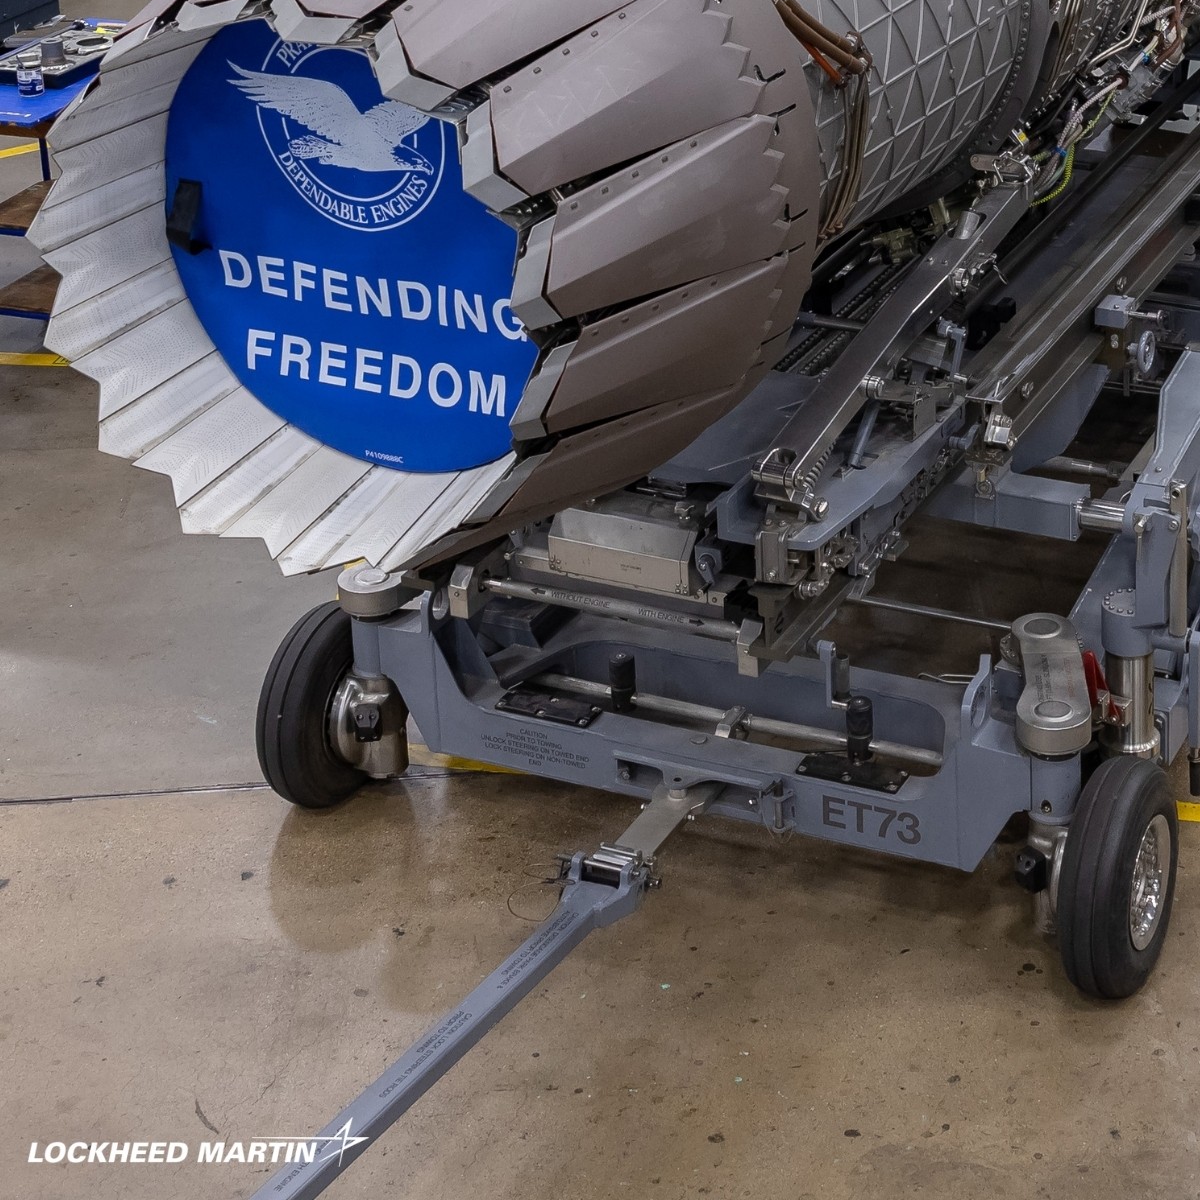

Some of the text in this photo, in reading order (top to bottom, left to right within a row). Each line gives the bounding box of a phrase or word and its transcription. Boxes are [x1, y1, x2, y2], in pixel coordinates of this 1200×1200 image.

[279, 151, 428, 224] DEPENDABLE ENGINES
[219, 250, 528, 342] DEFENDING
[246, 328, 507, 417] FREEDOM
[551, 591, 611, 609] WITHOUT ENGINE
[638, 608, 686, 624] WITH ENGINE
[506, 732, 562, 750] PRIOR TO TOWING
[520, 728, 548, 740] CAUTION
[480, 733, 590, 763] UNLOCK STEERING ON TOWED END
[484, 742, 502, 751] LOCK
[503, 745, 534, 758] STEERING
[546, 754, 586, 769] NON-TOWED
[823, 794, 921, 845] ET73
[446, 1009, 464, 1028] PRIOR
[432, 1034, 448, 1050] LOCK
[405, 1048, 434, 1076] STEERING
[274, 1168, 300, 1194] ENGINE
